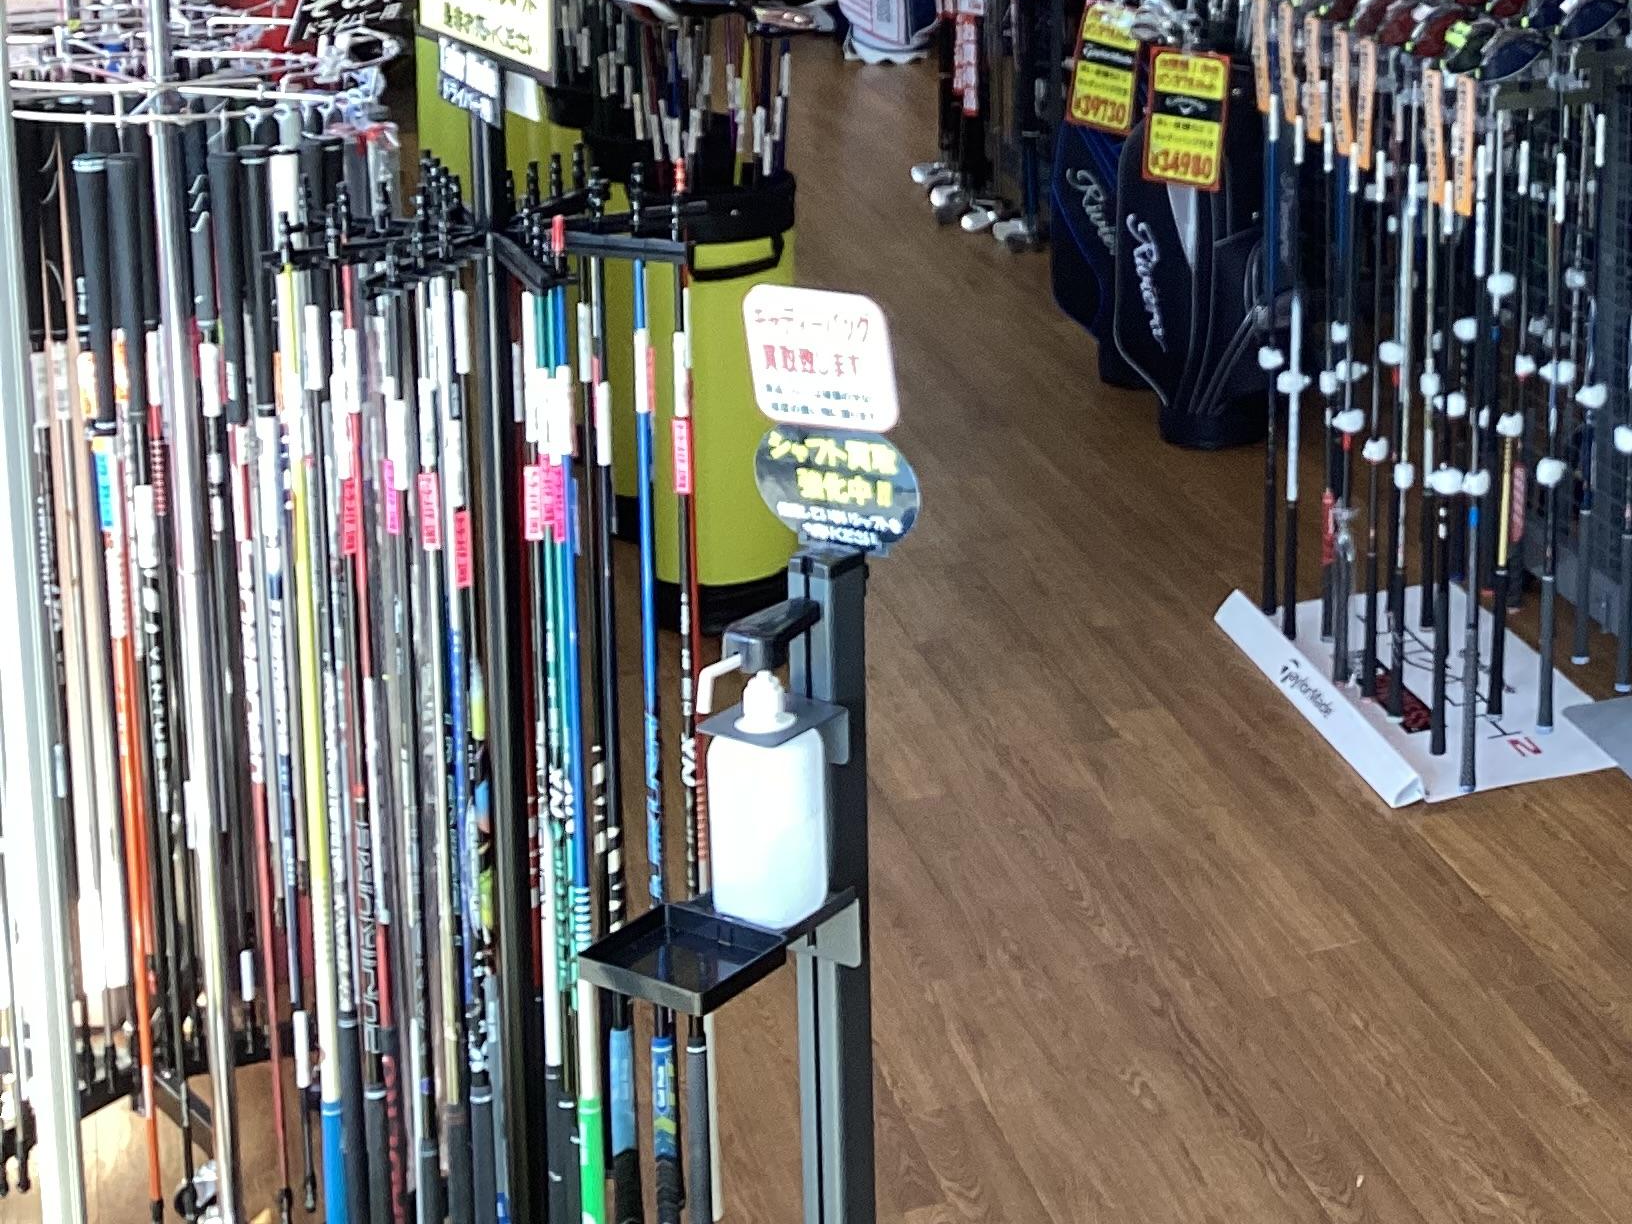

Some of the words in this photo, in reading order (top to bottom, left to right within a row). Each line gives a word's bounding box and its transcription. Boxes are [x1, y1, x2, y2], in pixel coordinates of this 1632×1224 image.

[767, 430, 898, 475] シャフト買取
